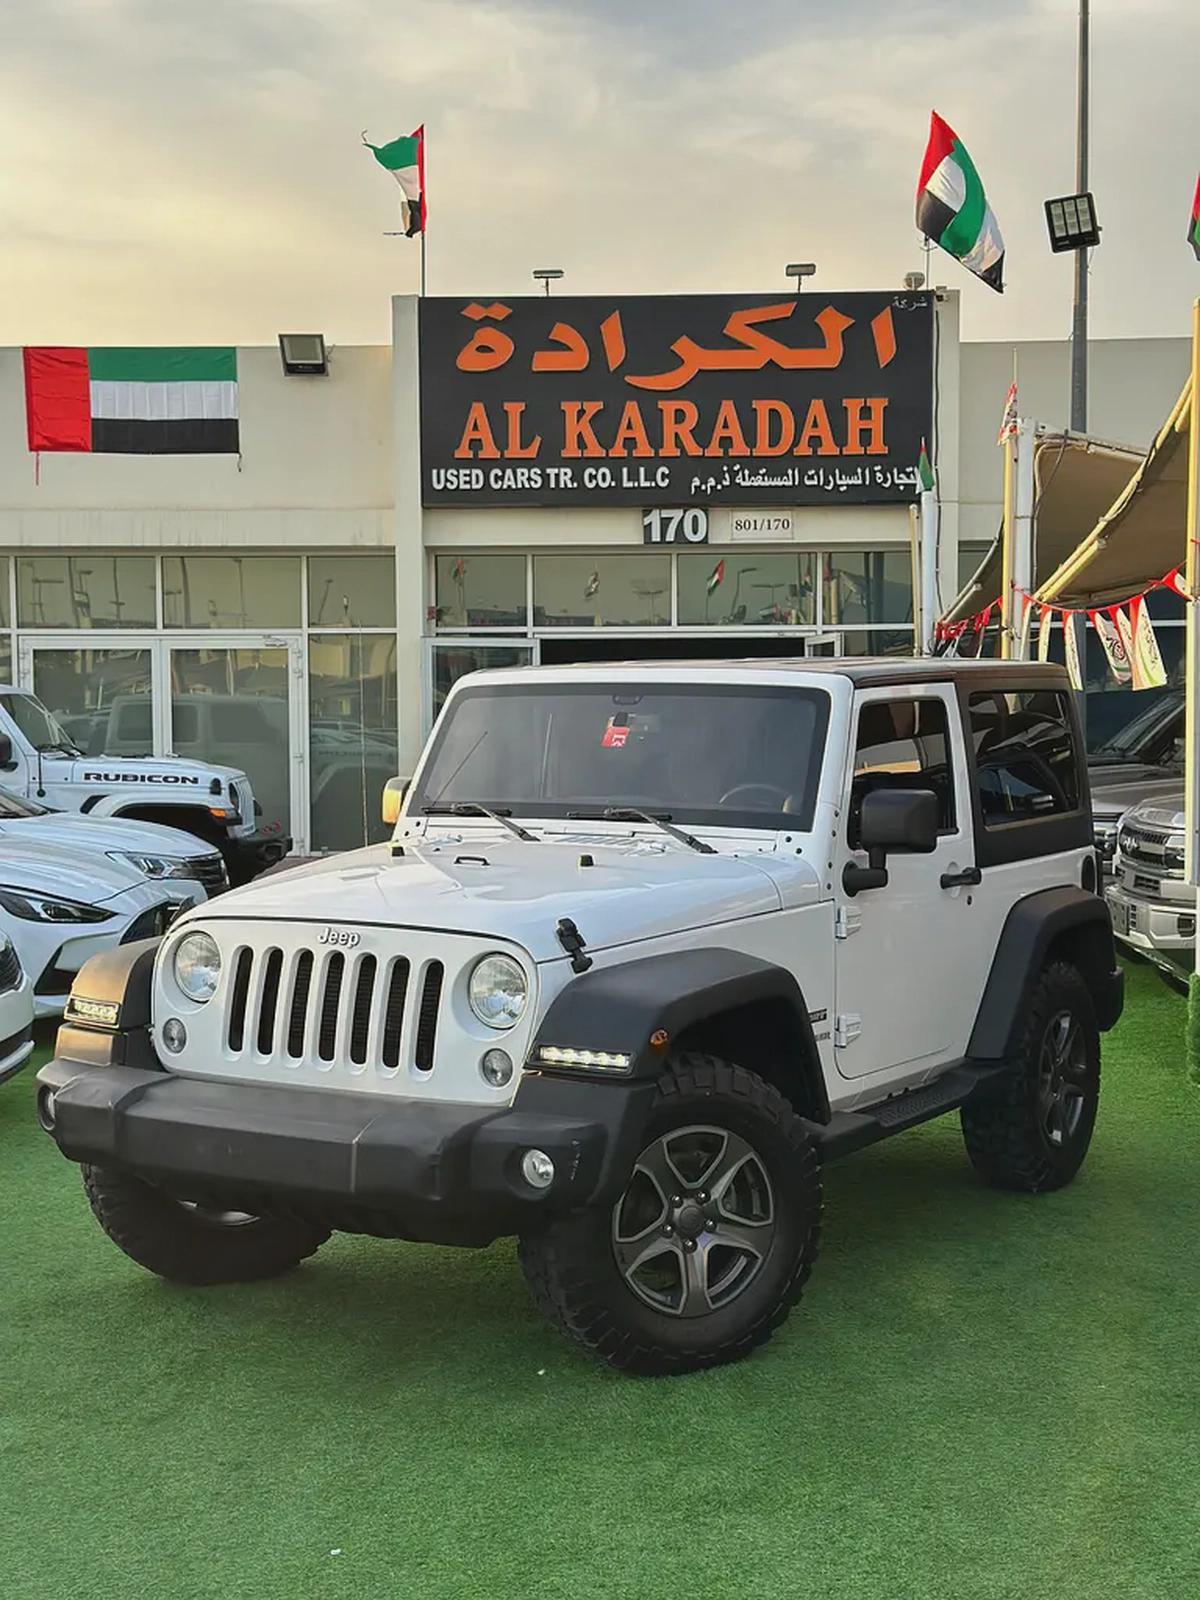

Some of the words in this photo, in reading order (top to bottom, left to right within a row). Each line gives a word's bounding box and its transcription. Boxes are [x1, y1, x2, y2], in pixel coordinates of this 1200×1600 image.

[892, 296, 928, 311] شركة
[456, 302, 897, 390] الكرادة
[454, 402, 542, 459] AL
[561, 398, 889, 458] KARADAH
[432, 468, 484, 490] USED
[489, 467, 543, 490] CARS
[546, 467, 578, 488] TR.
[583, 467, 616, 488] CO.
[622, 466, 670, 488] L.L.C
[690, 465, 730, 495] ذ.م.م
[734, 463, 799, 487] المستعملة
[803, 467, 870, 492] السيارات
[643, 508, 707, 542] 170
[735, 518, 790, 531] 801/170
[83, 772, 199, 785] RUBICON
[317, 927, 361, 950] Jeep
